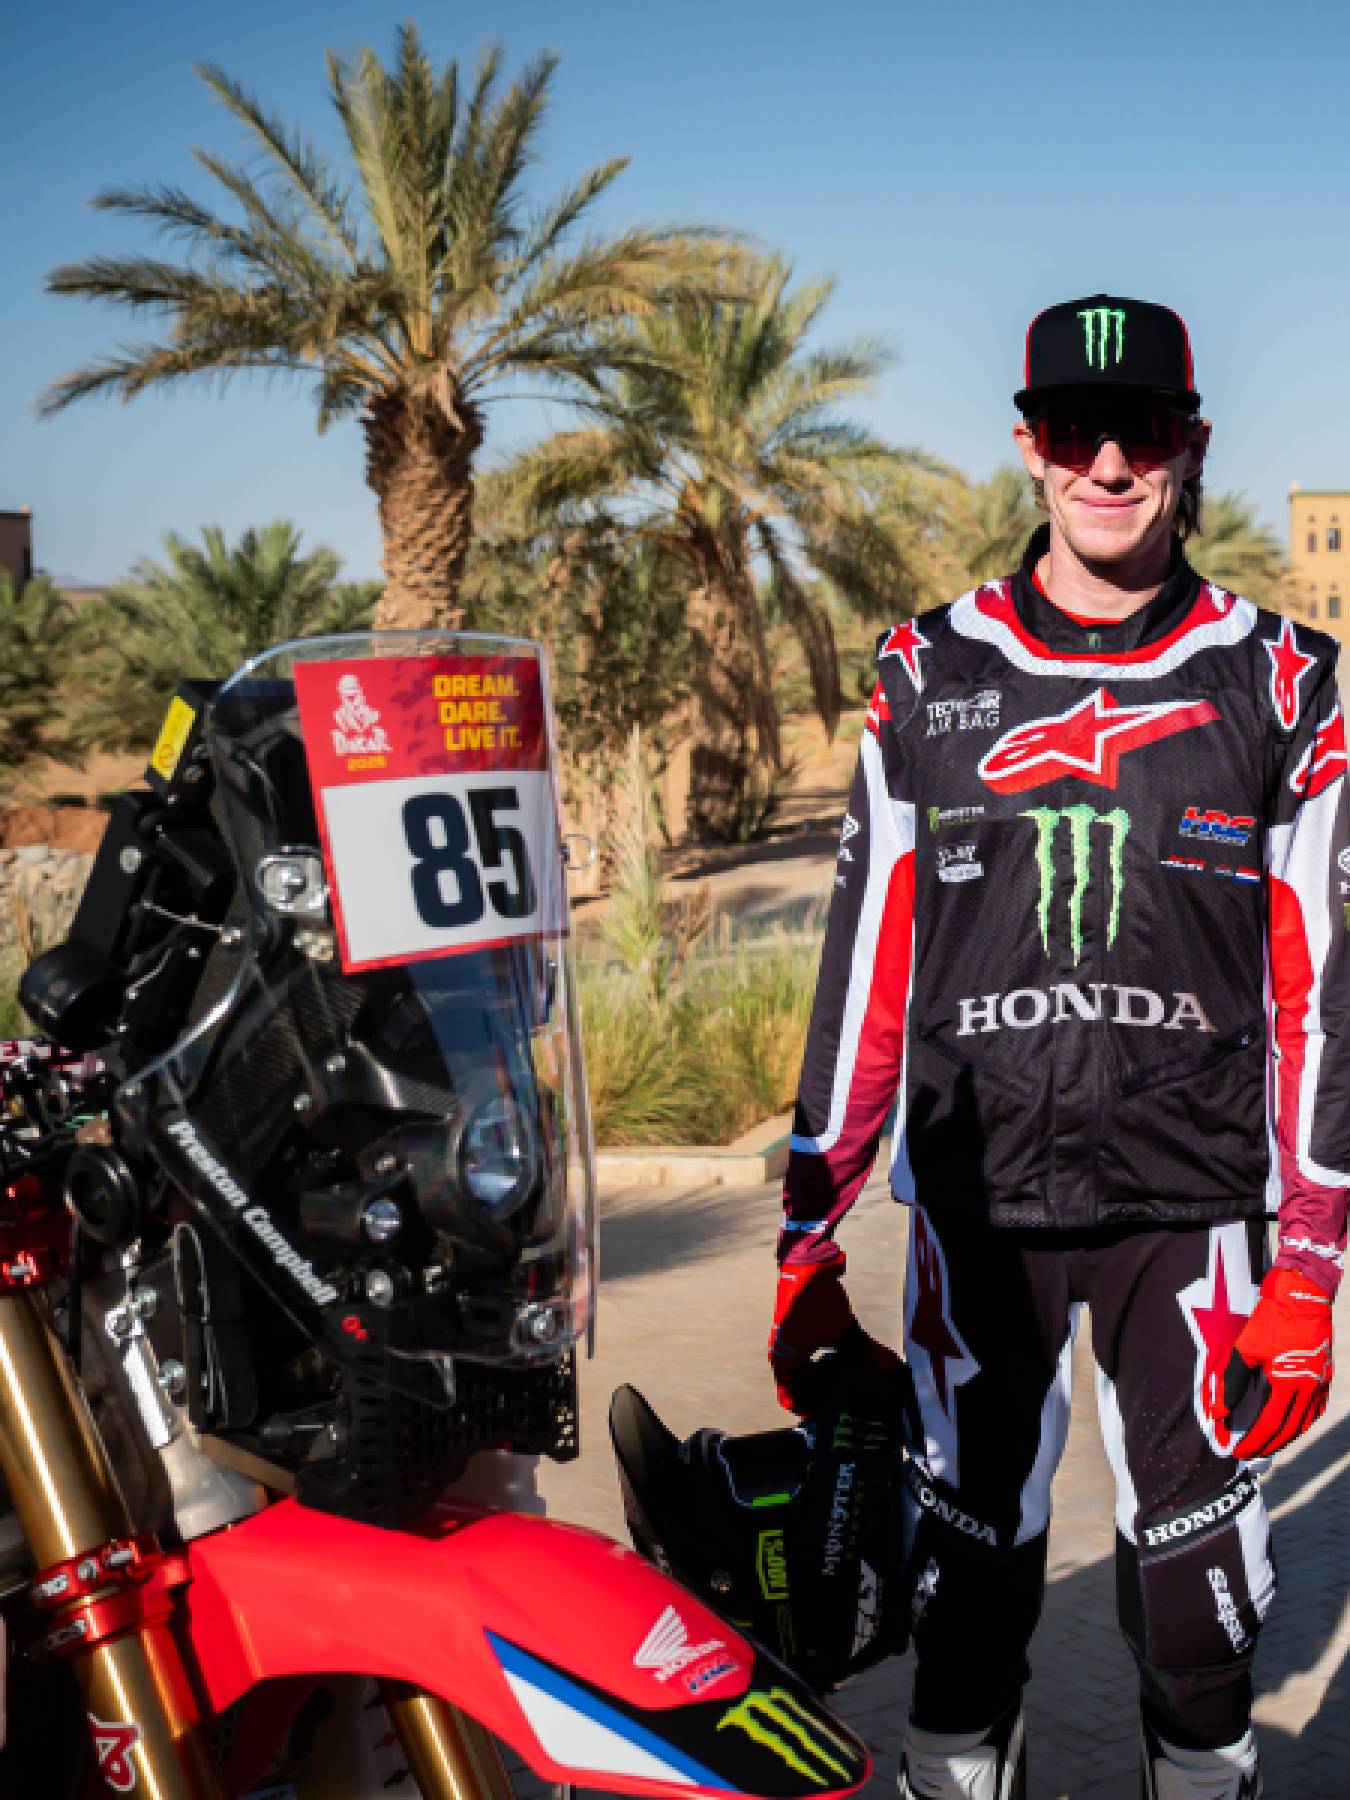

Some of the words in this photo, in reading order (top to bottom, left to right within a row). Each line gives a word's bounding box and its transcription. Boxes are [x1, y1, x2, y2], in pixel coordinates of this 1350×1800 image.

[432, 675, 520, 697] DREAM.
[439, 701, 508, 724] DARE.
[445, 726, 494, 751] LIVE
[498, 724, 523, 749] IT.
[402, 787, 537, 929] 85
[957, 984, 1219, 1036] HONDA
[167, 1121, 250, 1209] Preston
[243, 1207, 340, 1306] Campbell
[1144, 1479, 1260, 1547] HONDA
